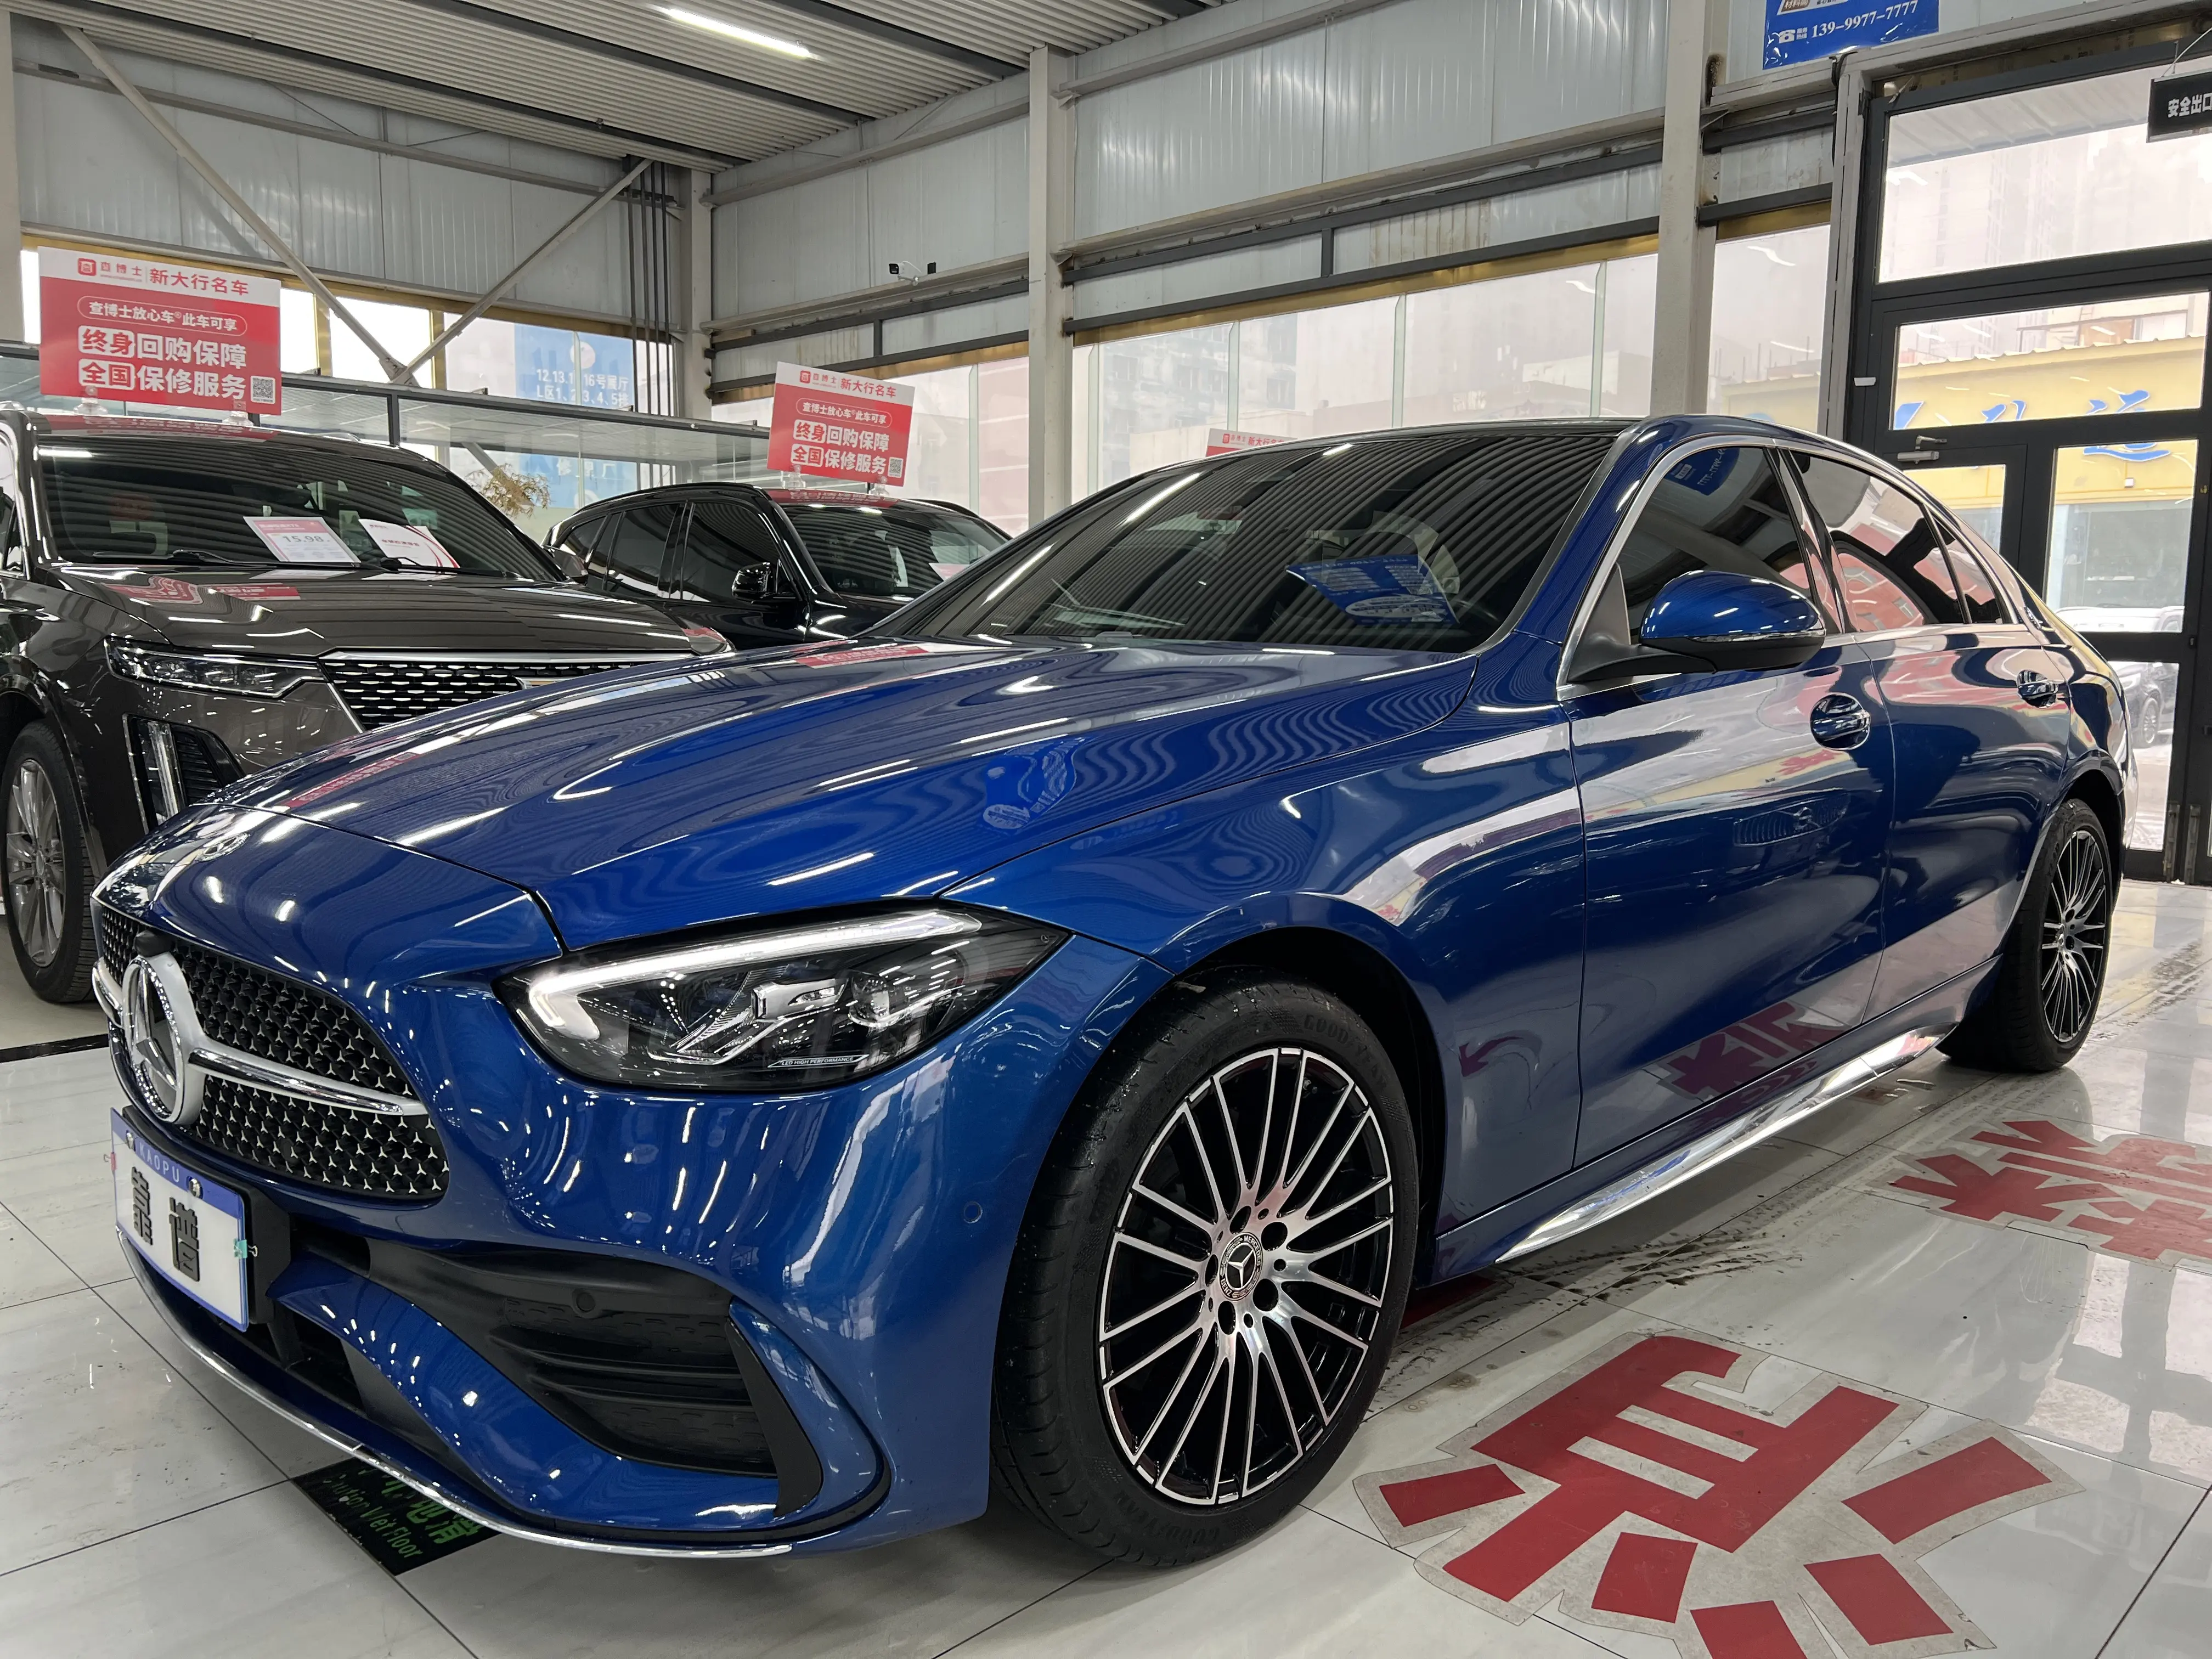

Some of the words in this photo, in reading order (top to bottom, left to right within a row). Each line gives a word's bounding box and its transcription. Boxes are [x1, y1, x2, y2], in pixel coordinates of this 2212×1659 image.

[1811, 1, 1918, 38] 139-9977-7777
[2168, 93, 2212, 118] 安全出口
[149, 267, 249, 295] 新大行名车
[82, 328, 246, 369] 终身回购保障
[82, 362, 246, 399] 全国保修服务
[840, 377, 897, 398] 新大行名车
[795, 421, 890, 453] 终身回购保障
[793, 445, 887, 475] 全国保修服务
[283, 534, 324, 543] 15.98
[137, 1143, 180, 1183] KAOPU
